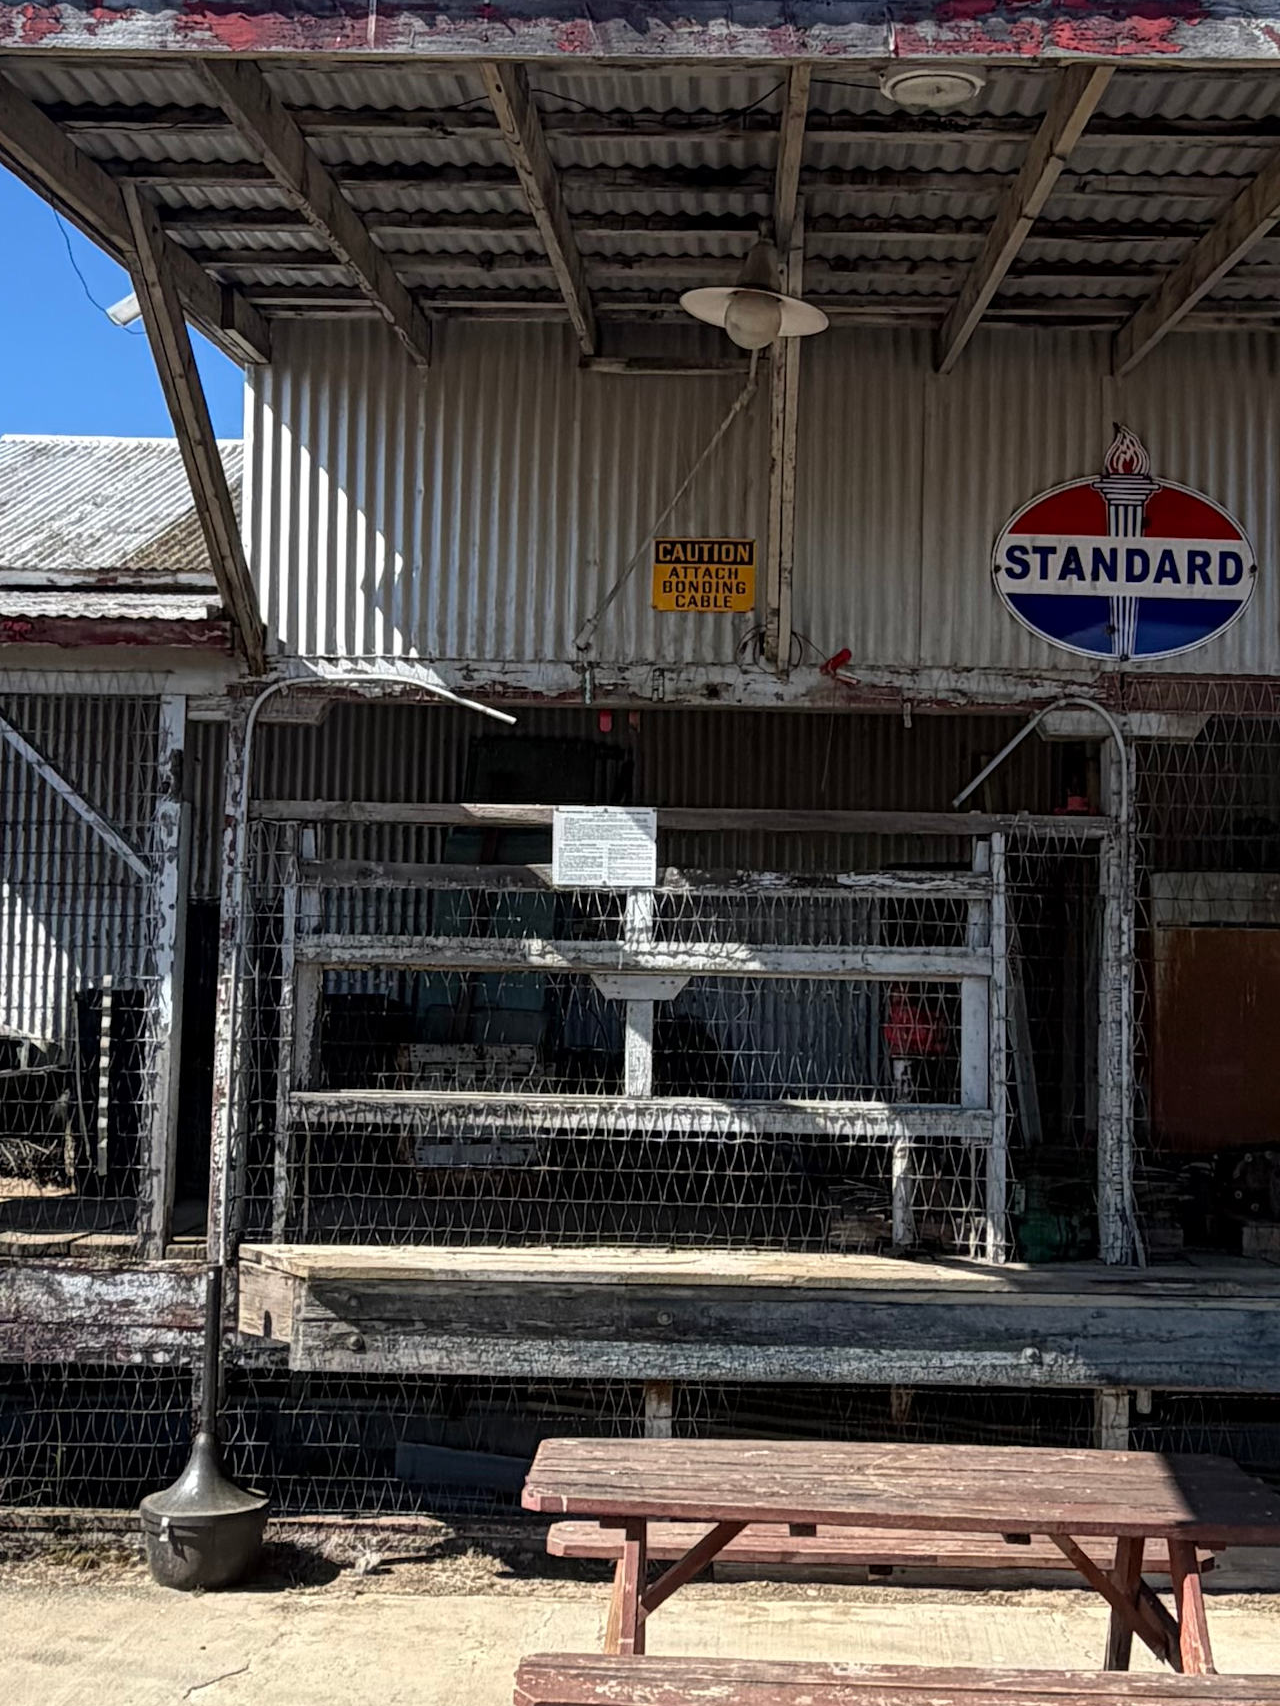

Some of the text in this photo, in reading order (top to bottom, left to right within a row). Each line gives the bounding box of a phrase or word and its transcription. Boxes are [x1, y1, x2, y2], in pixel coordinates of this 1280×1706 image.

[659, 543, 750, 562] CAUTION
[1004, 545, 1244, 586] STANDARD
[668, 567, 739, 579] ATTACH
[662, 580, 747, 594] BONDING
[675, 595, 733, 608] CABLE
